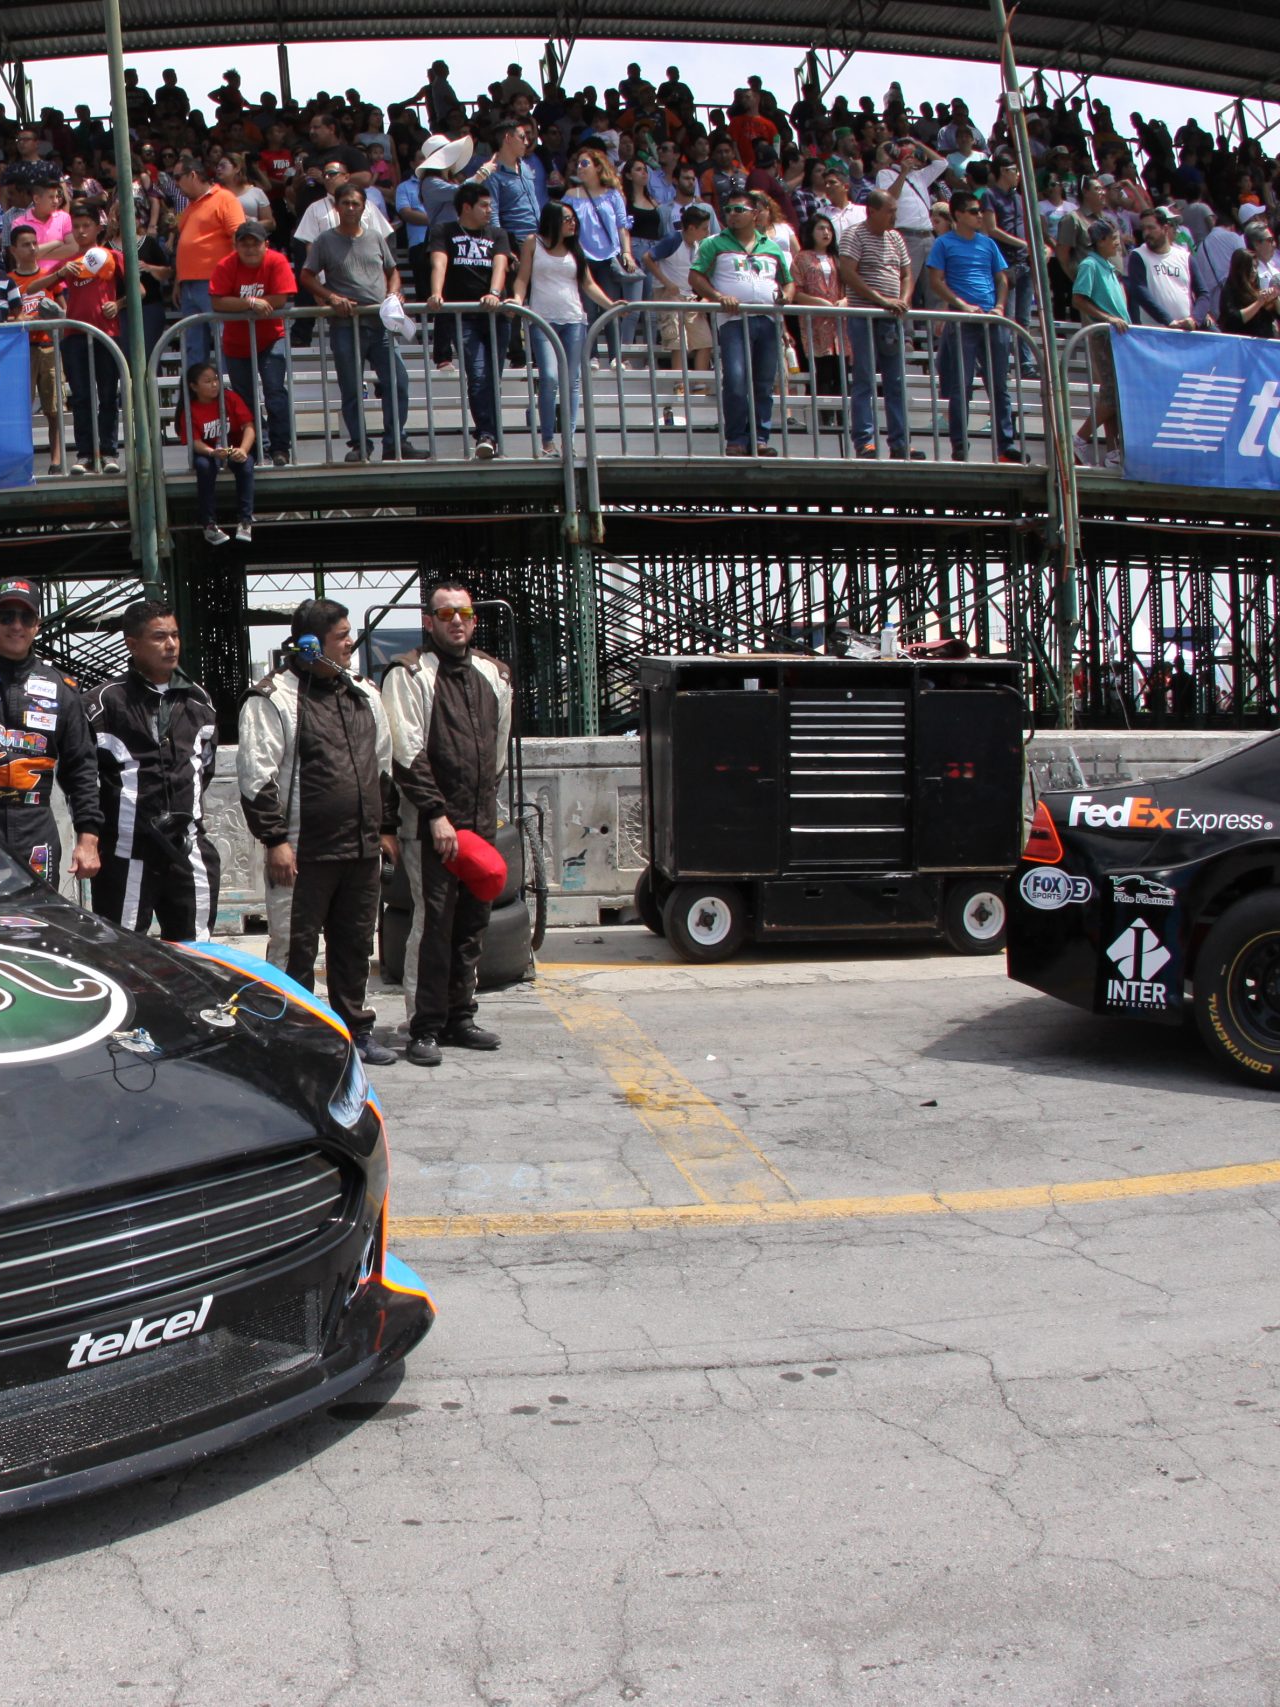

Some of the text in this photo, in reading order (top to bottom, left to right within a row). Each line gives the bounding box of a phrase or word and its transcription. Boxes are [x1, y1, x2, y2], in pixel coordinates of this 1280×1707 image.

[1154, 264, 1180, 277] POLO
[1069, 796, 1175, 829] FedEx
[1032, 875, 1087, 898] FOX 3
[1032, 892, 1062, 900] SPORTS
[1114, 892, 1174, 906] Pole Position
[1107, 980, 1166, 1004] INTER
[1207, 992, 1274, 1074] CONTINENTAL
[66, 1294, 213, 1368] telcel
